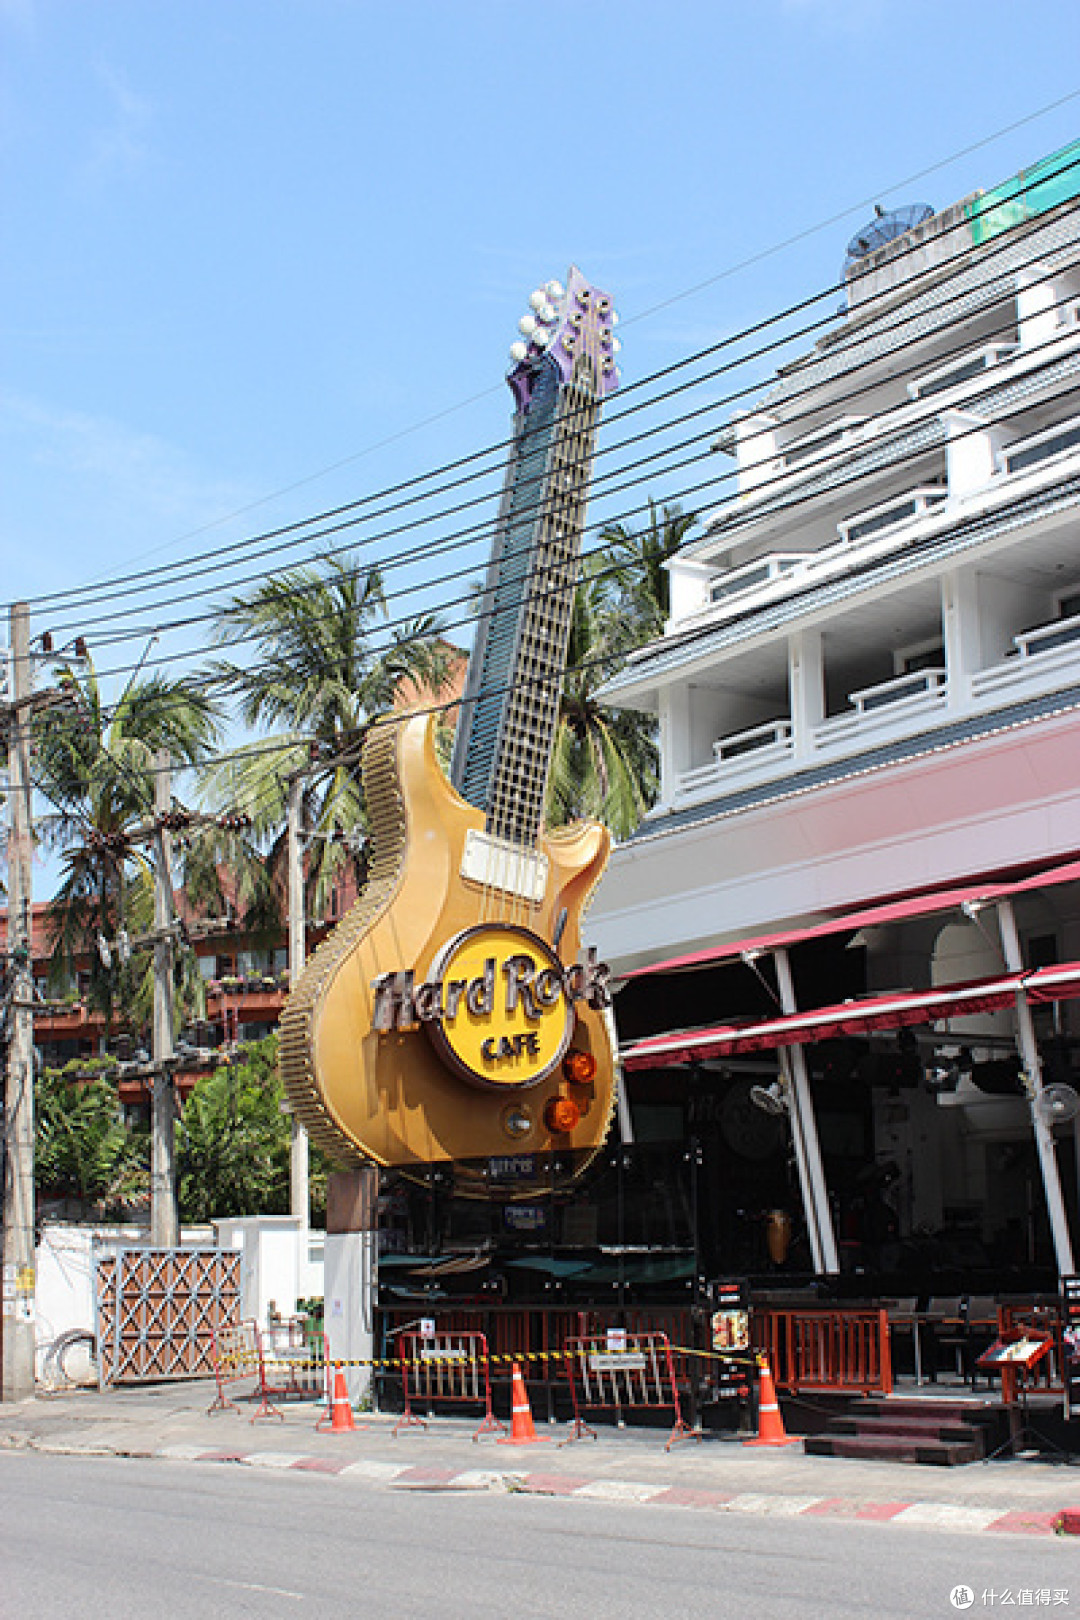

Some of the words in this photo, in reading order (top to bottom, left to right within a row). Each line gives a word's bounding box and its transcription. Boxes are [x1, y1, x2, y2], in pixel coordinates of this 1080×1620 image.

[370, 958, 496, 1030] Hard
[502, 945, 611, 1019] Rock
[480, 1032, 541, 1061] CAFE
